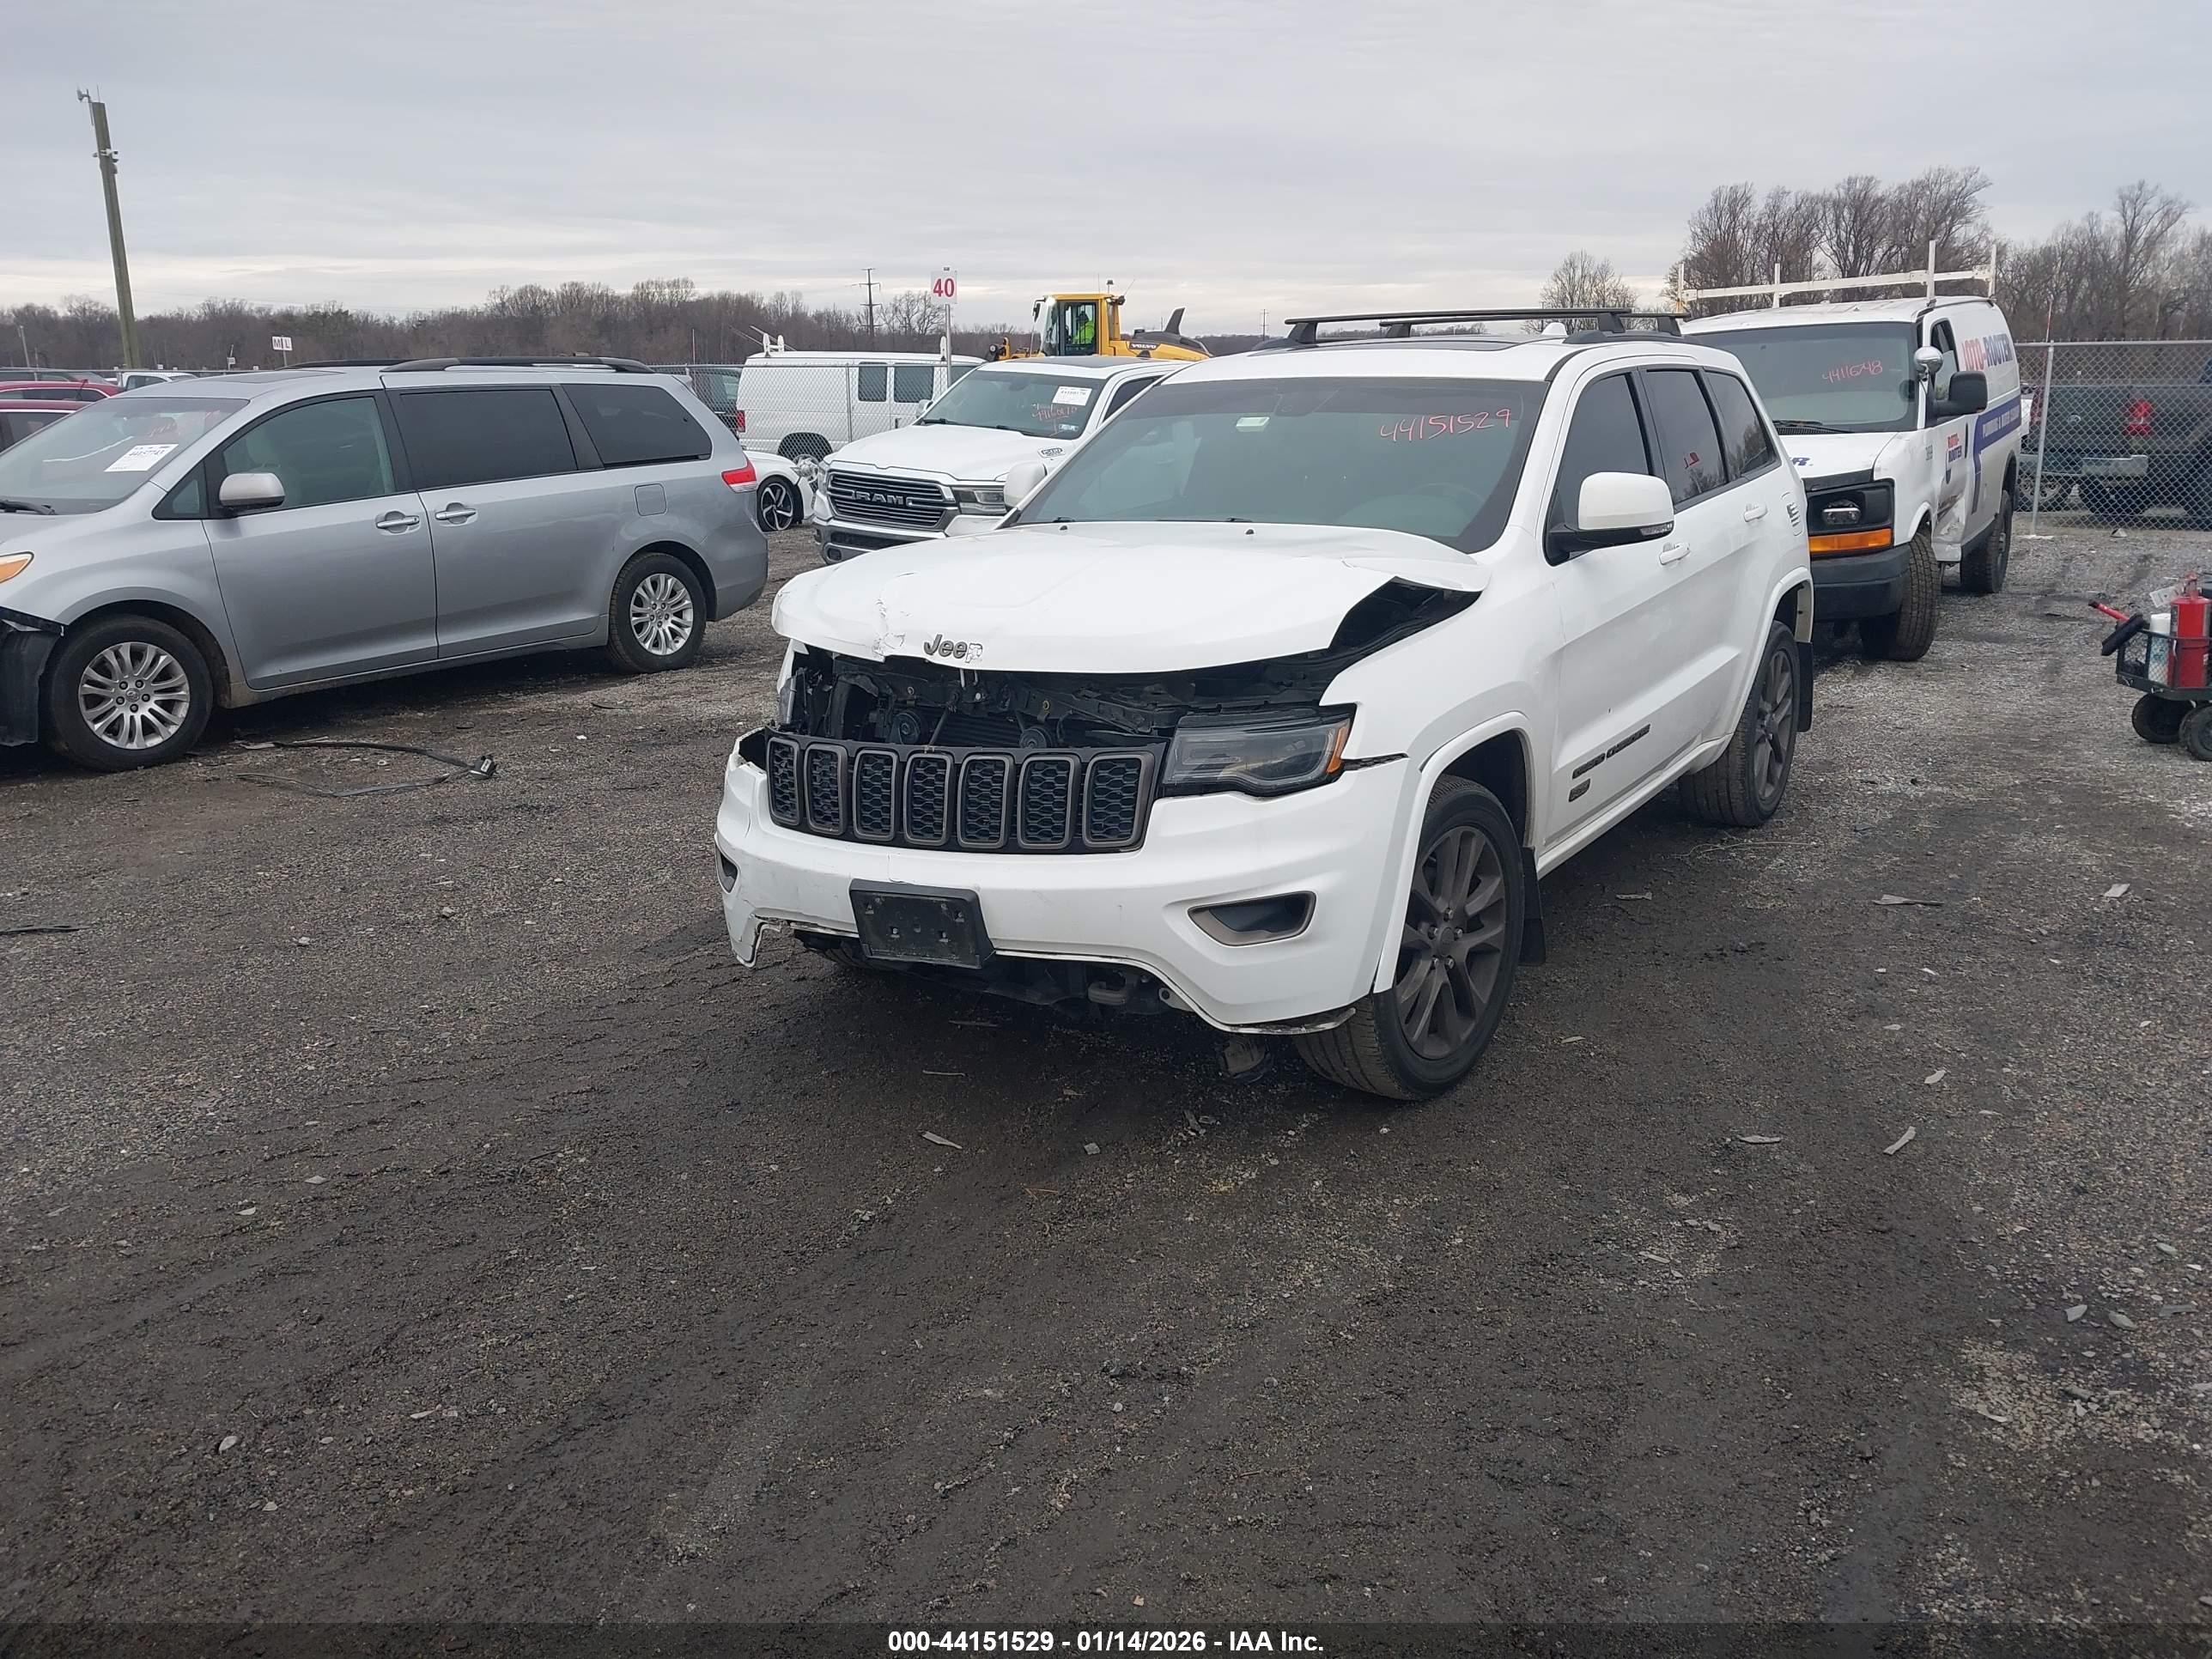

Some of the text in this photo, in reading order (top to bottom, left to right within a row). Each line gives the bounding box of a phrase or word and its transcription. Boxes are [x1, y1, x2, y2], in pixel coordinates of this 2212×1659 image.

[933, 277, 955, 298] 40
[1379, 408, 1512, 442] 44151529
[855, 490, 904, 506] RAM
